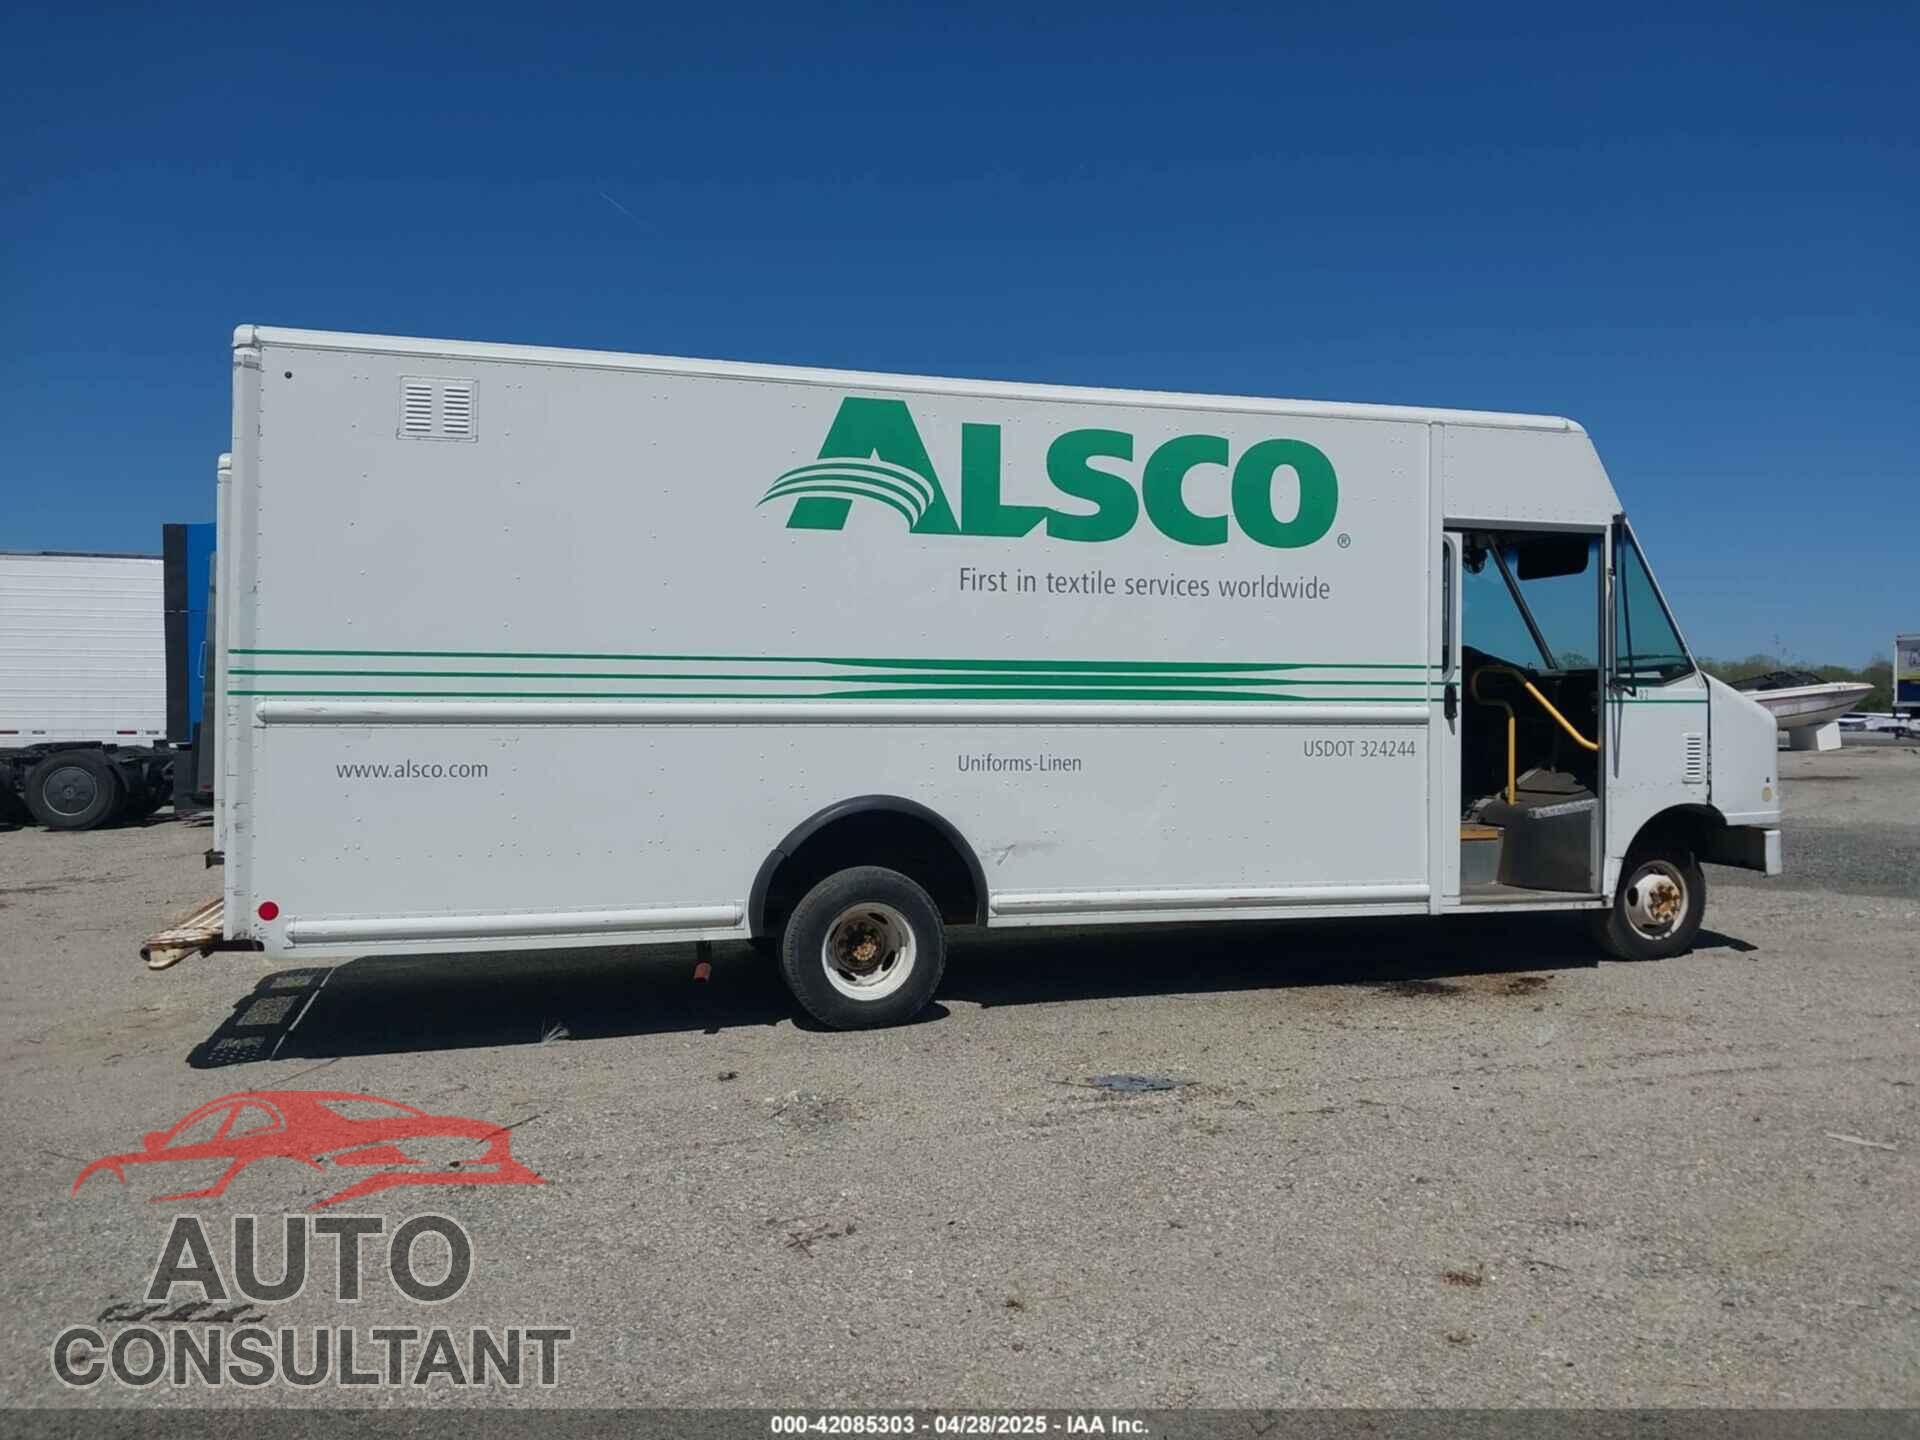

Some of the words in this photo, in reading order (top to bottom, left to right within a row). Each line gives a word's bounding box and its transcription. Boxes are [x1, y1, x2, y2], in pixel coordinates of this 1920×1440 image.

[757, 396, 1339, 549] ALSCO
[959, 567, 1008, 592] First
[1016, 569, 1036, 593] in
[1046, 571, 1116, 595] textile
[1124, 574, 1210, 597] services
[1218, 575, 1331, 600] worldwide
[1303, 740, 1354, 757] USDOT
[1360, 740, 1416, 757] 324244
[336, 759, 489, 778] www.alsco.com
[957, 752, 1082, 772] Uniforms-Linen
